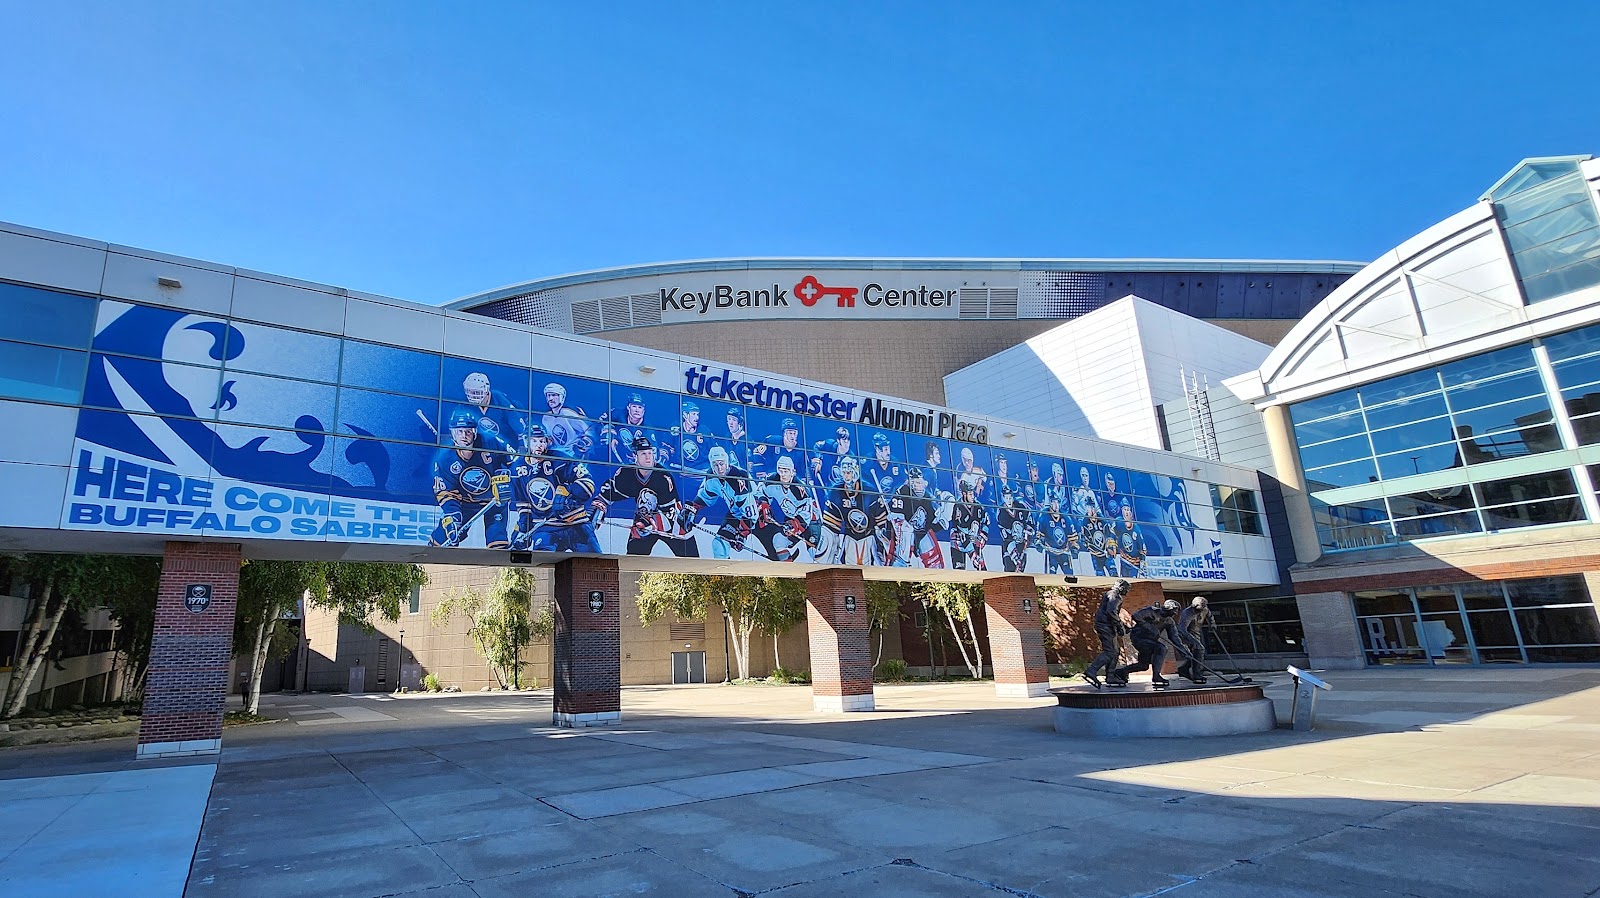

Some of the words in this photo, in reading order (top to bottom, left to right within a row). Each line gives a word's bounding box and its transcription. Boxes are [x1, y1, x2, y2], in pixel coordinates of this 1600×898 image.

[660, 284, 788, 313] KeyBank
[863, 283, 957, 307] Center
[685, 366, 857, 421] ticketmaster
[859, 397, 934, 435] Alumni
[938, 413, 988, 444] Plaza
[74, 449, 213, 507] HERE
[225, 487, 355, 518] COME
[366, 505, 440, 524] THE
[745, 504, 757, 518] 81
[892, 498, 903, 508] 39
[69, 503, 281, 534] BUFFALO
[291, 518, 432, 541] SABRES
[1174, 556, 1203, 568] COME
[1204, 548, 1224, 568] THE
[1190, 569, 1226, 579] SABRES
